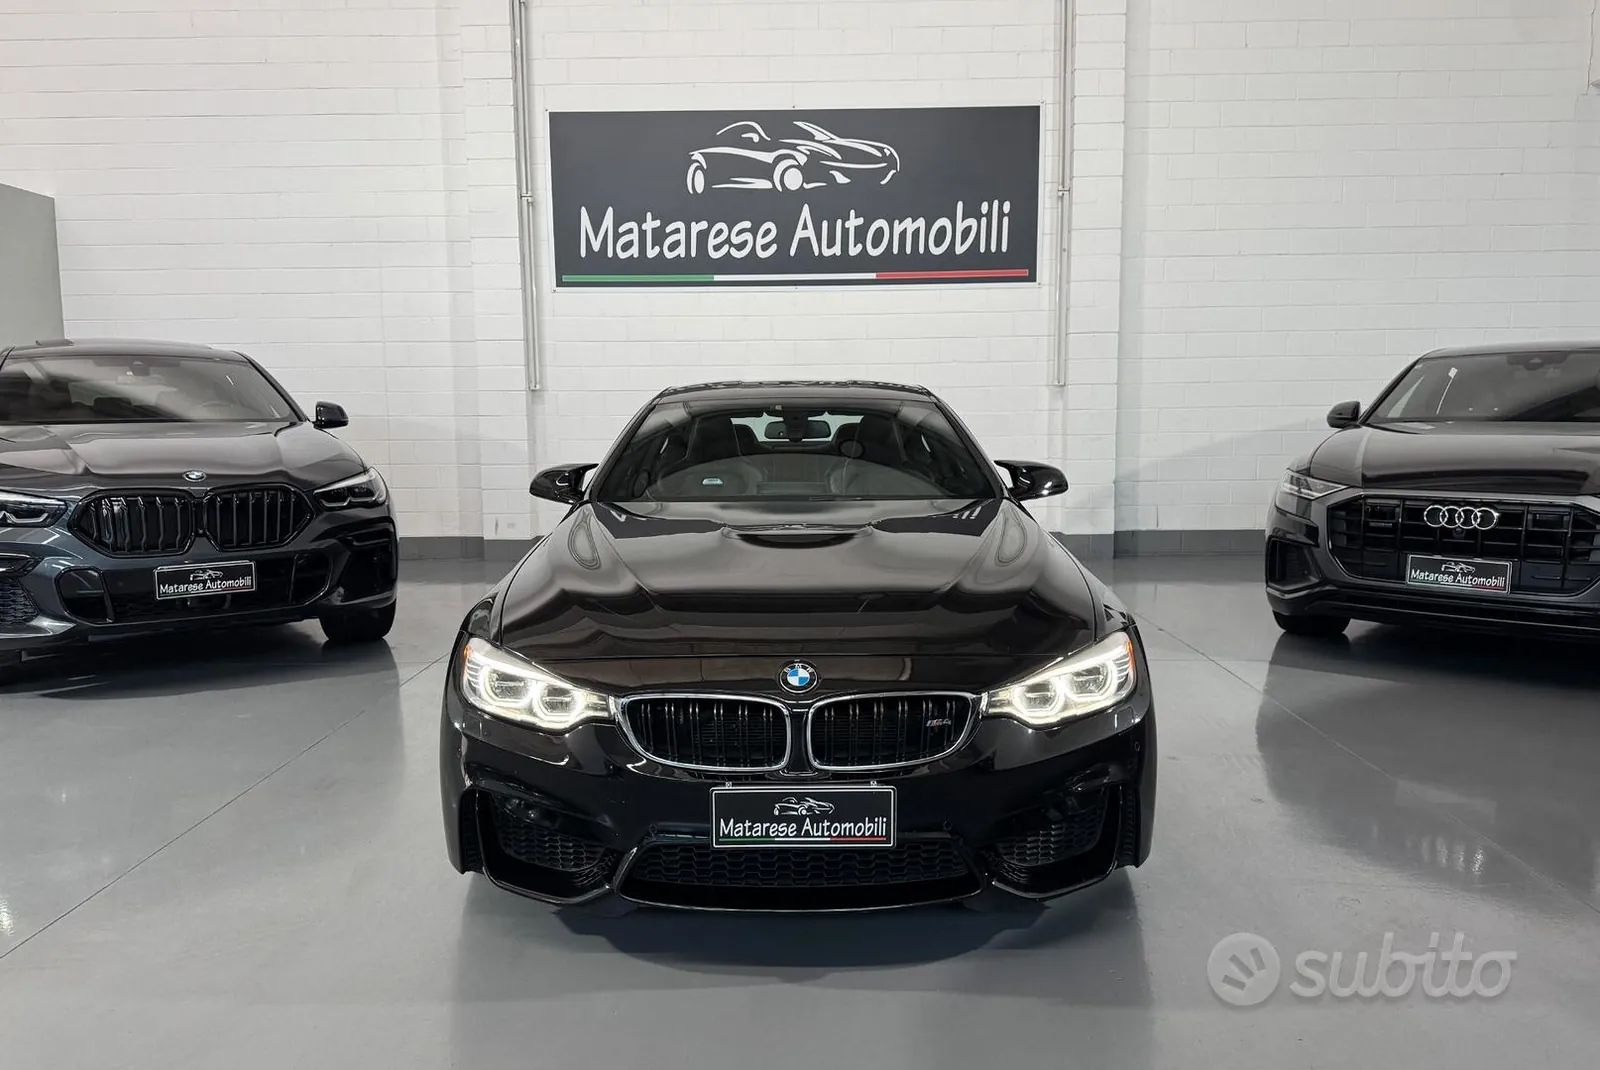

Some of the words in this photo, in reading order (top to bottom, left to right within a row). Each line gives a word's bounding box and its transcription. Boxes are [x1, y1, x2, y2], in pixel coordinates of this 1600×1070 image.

[579, 205, 778, 259] Matarese
[789, 199, 1011, 257] Automobili
[160, 583, 204, 594] Matarese
[205, 576, 252, 590] Automobili
[1410, 568, 1454, 583] Matarese
[1455, 573, 1505, 587] Automobili
[719, 818, 797, 837] Matarese
[801, 816, 887, 837] Automobili
